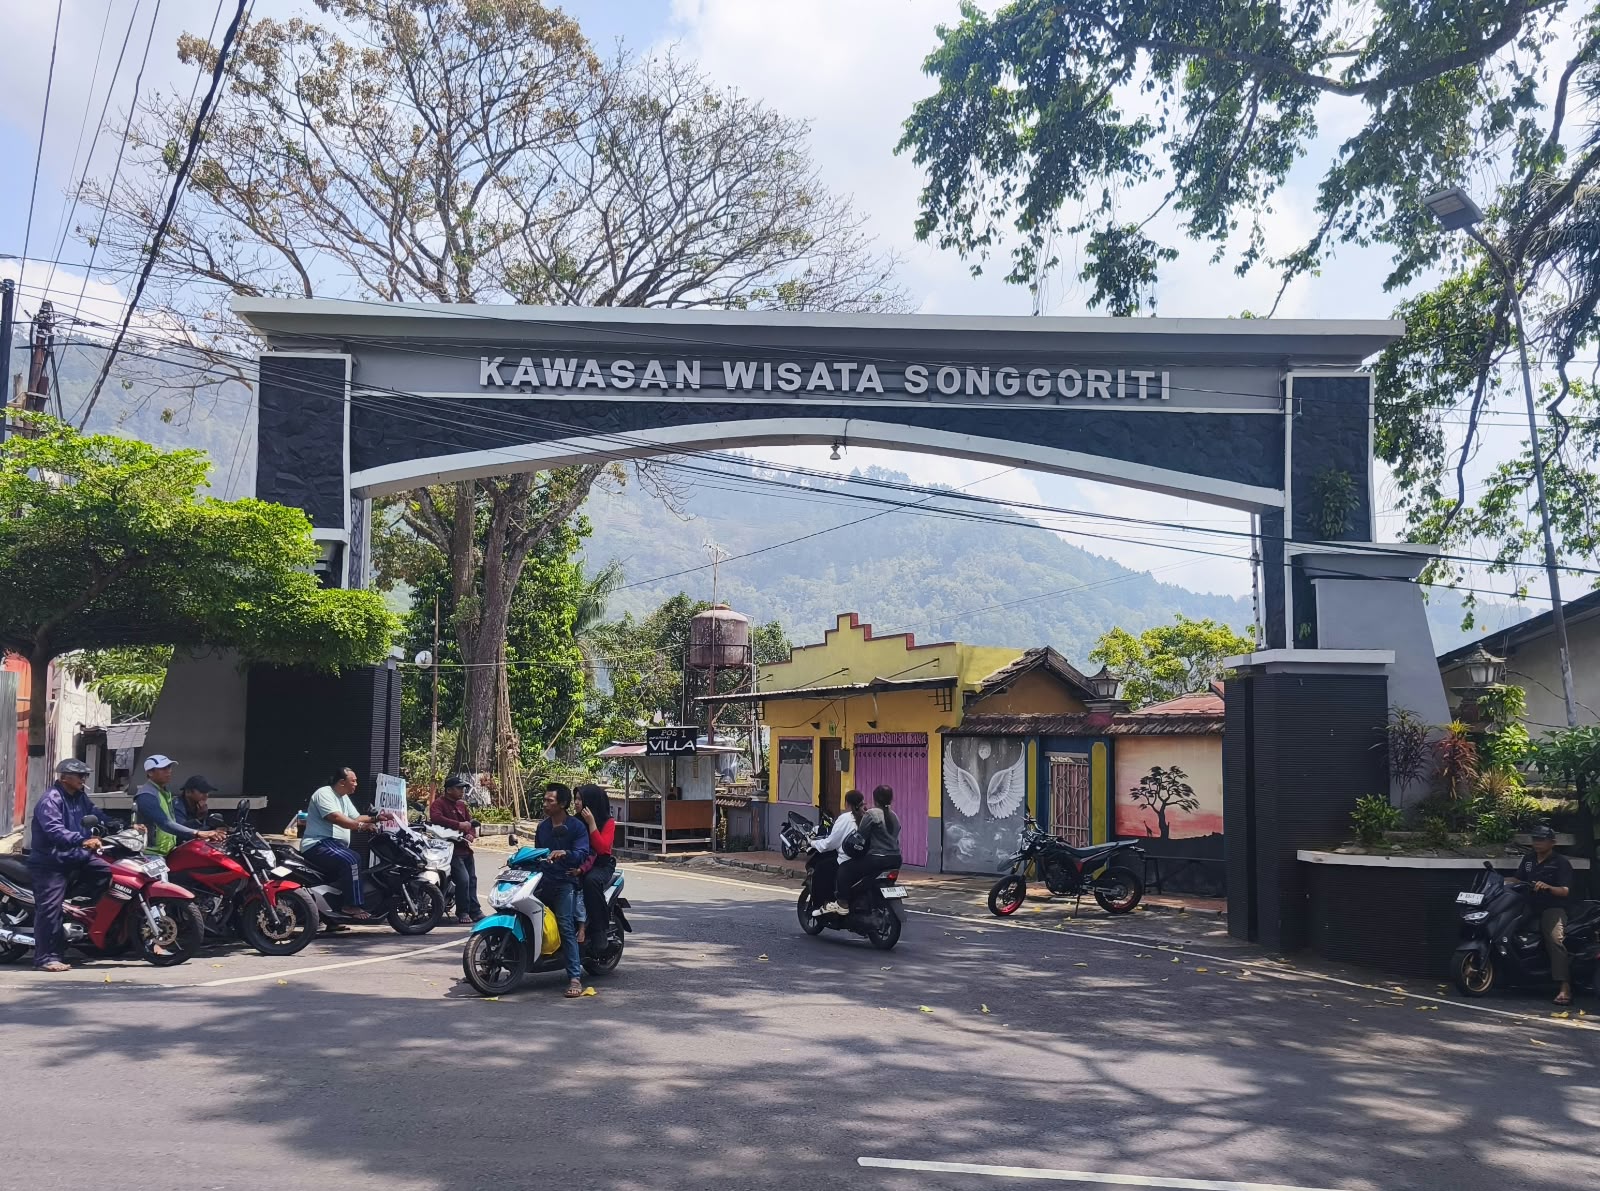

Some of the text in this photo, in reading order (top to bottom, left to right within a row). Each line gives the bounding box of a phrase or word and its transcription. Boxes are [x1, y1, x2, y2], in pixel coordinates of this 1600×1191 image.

[479, 356, 1171, 400] KAWASAN WISATA SONGGORITI
[649, 740, 696, 751] VILLA
[114, 883, 132, 894] YAMAHA
